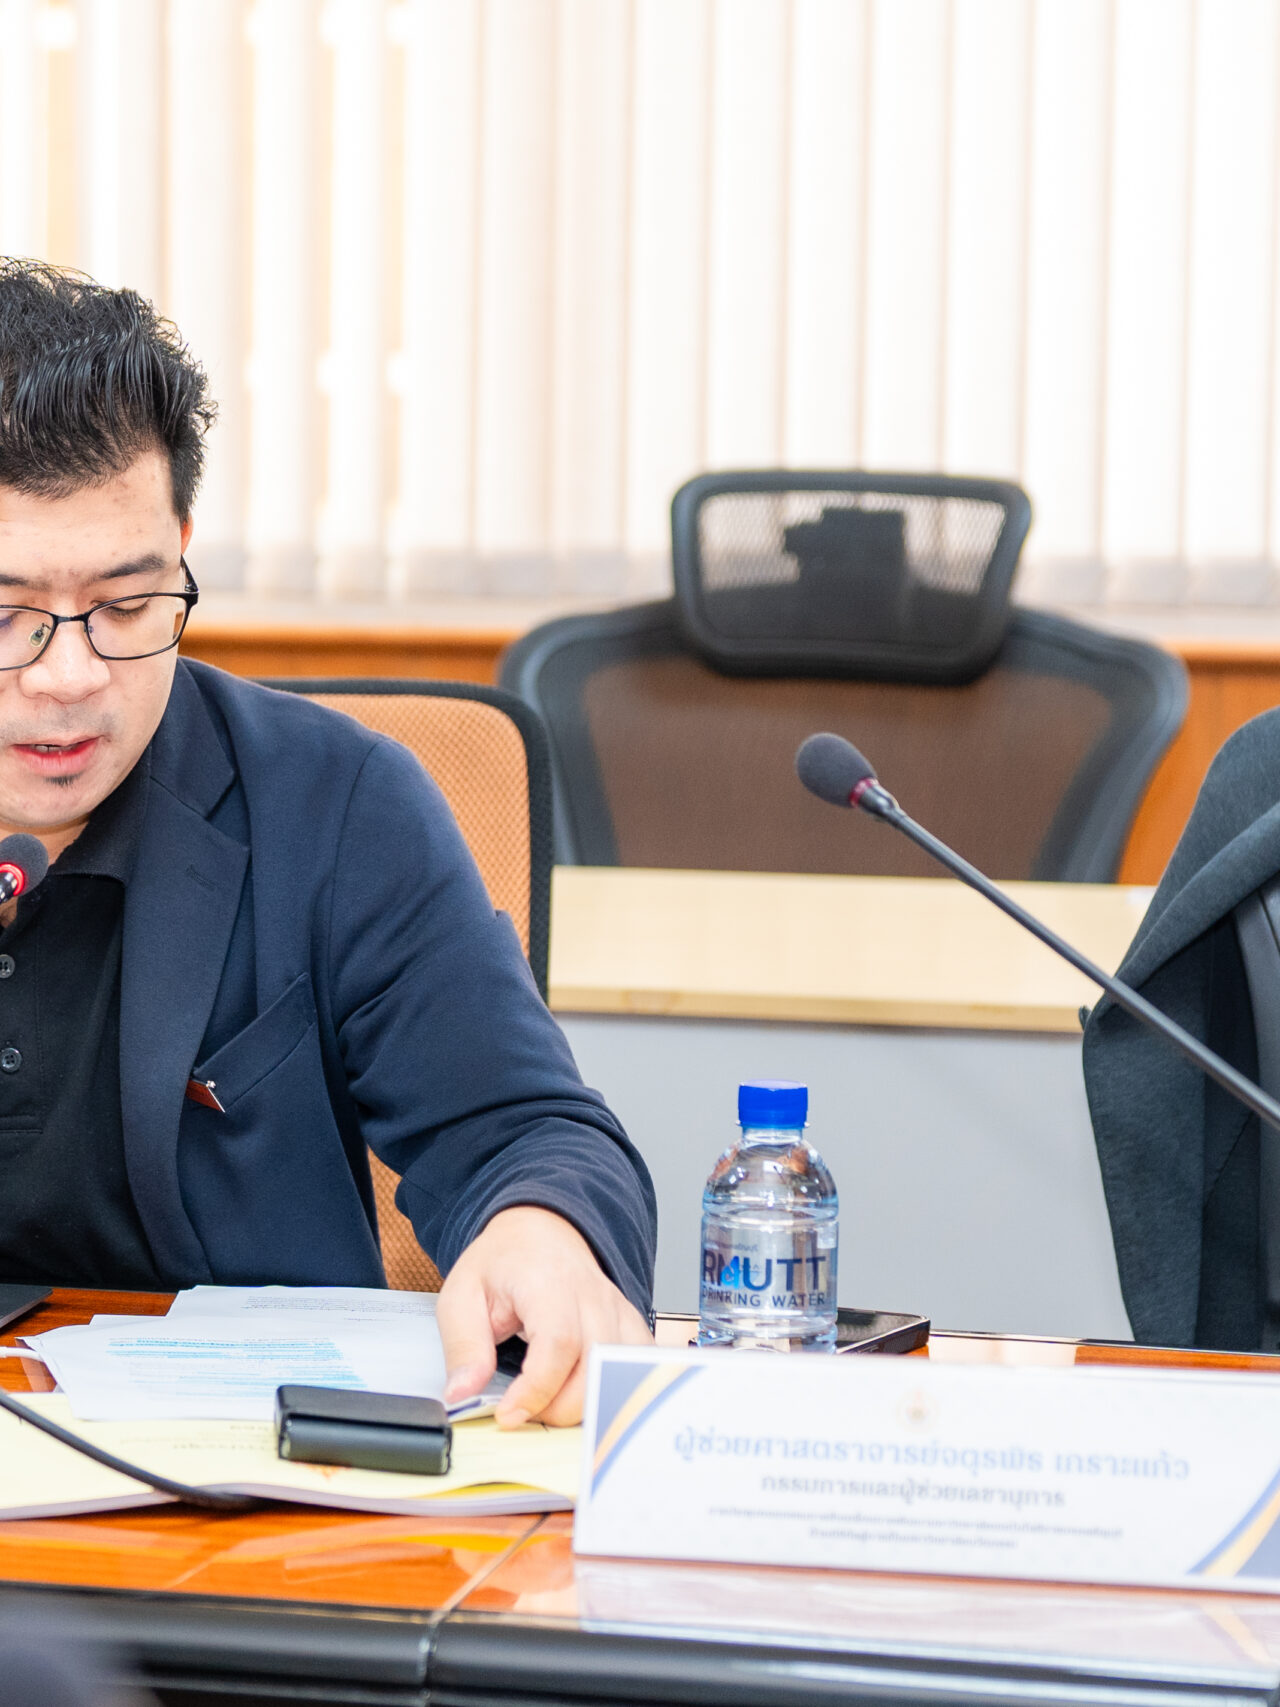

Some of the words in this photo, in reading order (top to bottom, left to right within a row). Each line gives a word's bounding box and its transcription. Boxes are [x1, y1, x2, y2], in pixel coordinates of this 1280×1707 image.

[702, 1248, 826, 1292] RMUTT
[702, 1286, 762, 1308] DRINKING
[772, 1291, 826, 1308] WATER
